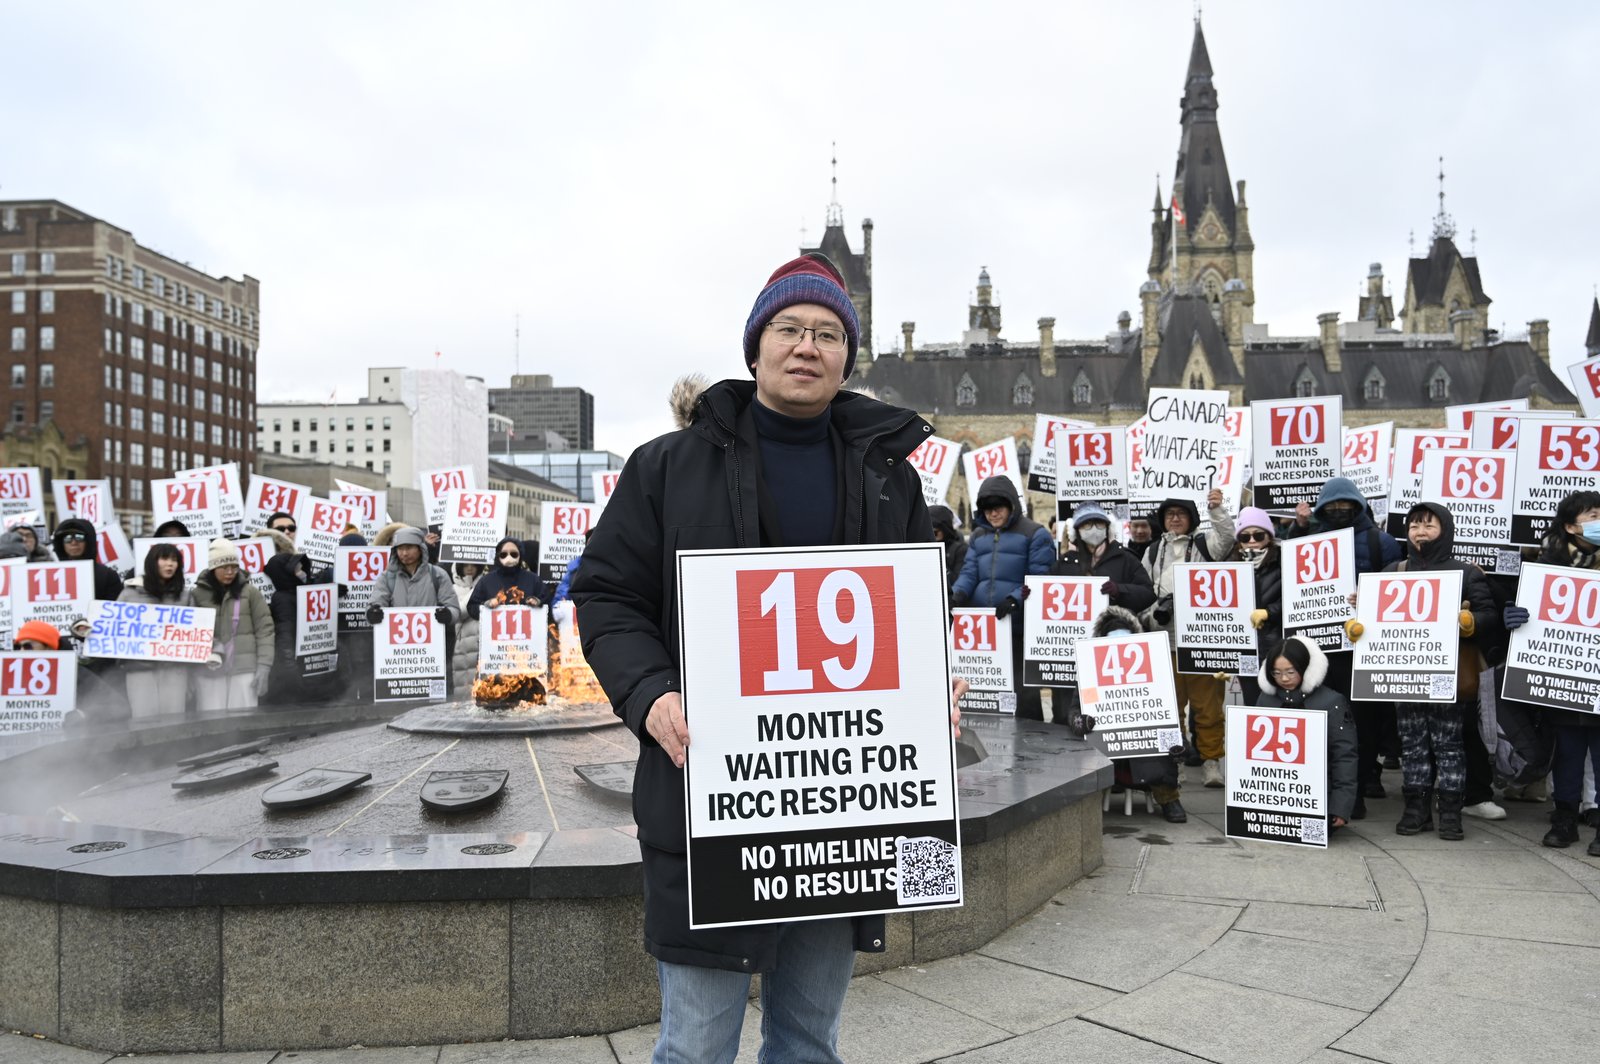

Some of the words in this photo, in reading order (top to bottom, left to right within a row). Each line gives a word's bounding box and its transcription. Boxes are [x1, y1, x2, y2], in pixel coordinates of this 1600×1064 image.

[1149, 396, 1226, 424] CANADA
[1277, 406, 1319, 445] 70
[1074, 434, 1107, 466] 13
[1145, 434, 1188, 460] WHAT
[1186, 439, 1218, 460] ARE
[1276, 448, 1318, 458] MONTHS
[1343, 432, 1374, 466] 23
[1546, 426, 1600, 470] 53
[977, 446, 1005, 479] 32
[1265, 460, 1307, 470] WAITING
[1310, 458, 1330, 467] FOR
[1074, 470, 1108, 478] MONTHS
[1260, 471, 1281, 481] IRCC
[1282, 469, 1335, 479] RESPONSE
[1342, 467, 1372, 477] MONTHS
[1449, 457, 1497, 498] 68
[0, 473, 29, 498] 30
[433, 472, 464, 497] 20
[1066, 479, 1099, 487] WAITING
[1365, 475, 1379, 484] FOR
[1543, 475, 1595, 487] MONTHS
[924, 486, 938, 494] FOR
[1082, 488, 1122, 497] RESPONSE
[1269, 487, 1282, 496] NO
[171, 483, 202, 510] 27
[263, 484, 292, 512] 31
[1273, 496, 1285, 505] NO
[461, 494, 493, 517] 36
[1446, 503, 1495, 513] MONTHS
[1520, 500, 1547, 511] IRCC
[172, 513, 205, 521] MONTHS
[315, 505, 347, 533] 39
[557, 508, 587, 534] 30
[1484, 516, 1507, 526] FOR
[1530, 519, 1543, 529] NO
[304, 539, 334, 551] WAITING
[352, 552, 384, 580] 39
[1300, 540, 1335, 582] 30
[34, 569, 72, 600] 11
[1194, 570, 1234, 608] 30
[1300, 585, 1335, 598] MONTHS
[309, 591, 329, 620] 39
[1047, 584, 1088, 620] 34
[1292, 598, 1326, 611] WAITING
[1329, 595, 1345, 606] FOR
[1382, 580, 1433, 622] 20
[1548, 576, 1600, 627] 90
[33, 604, 73, 614] MONTHS
[101, 602, 148, 621] STOP
[155, 607, 195, 625] THE
[1288, 612, 1306, 623] IRCC
[1307, 606, 1351, 621] RESPONSE
[65, 614, 83, 622] FOR
[1195, 613, 1234, 621] MONTHS
[393, 613, 427, 644] 36
[497, 610, 527, 640] 11
[761, 569, 875, 691] 19
[1046, 626, 1086, 634] MONTHS
[1186, 624, 1224, 633] WAITING
[1226, 625, 1244, 633] FOR
[1306, 625, 1342, 637] TIMELINES
[958, 615, 992, 650] 31
[1381, 629, 1430, 639] MONTHS
[1543, 628, 1600, 646] MONTHS
[1036, 637, 1074, 646] WAITING
[1181, 634, 1201, 643] IRCC
[1203, 635, 1251, 645] RESPONSE
[393, 648, 427, 656] MONTHS
[1369, 641, 1416, 652] WAITING
[1419, 641, 1442, 651] FOR
[1527, 639, 1583, 657] WAITING
[958, 656, 993, 664] MONTHS
[1191, 651, 1201, 659] NO
[1361, 655, 1386, 665] IRCC
[1388, 655, 1449, 665] RESPONSE
[1516, 652, 1546, 667] IRCC
[385, 657, 418, 666] WAITING
[1102, 644, 1148, 685] 42
[1194, 660, 1205, 668] NO
[1207, 661, 1239, 669] RESULTS
[380, 667, 398, 675] IRCC
[399, 666, 441, 674] RESPONSE
[952, 667, 984, 675] WAITING
[986, 667, 1002, 675] FOR
[1042, 672, 1053, 680] NO
[8, 659, 51, 695] 18
[1371, 674, 1384, 683] NO
[1527, 674, 1542, 685] NO
[1105, 687, 1150, 700] MONTHS
[1374, 684, 1387, 693] NO
[1530, 685, 1546, 697] NO
[6, 700, 51, 709] MONTHS
[968, 701, 997, 710] RESULTS
[1095, 700, 1139, 713] WAITING
[1142, 698, 1163, 710] FOR
[41, 711, 62, 719] FOR
[1115, 710, 1171, 723] RESPONSE
[758, 708, 884, 742] MONTHS
[1102, 732, 1115, 742] NO
[1251, 716, 1300, 763] 25
[1107, 742, 1121, 751] NO
[725, 747, 852, 783] WAITING
[862, 744, 918, 777] FOR
[1251, 766, 1298, 780] MONTHS
[1240, 779, 1285, 793] WAITING
[1289, 783, 1311, 795] FOR
[709, 790, 775, 821] IRCC
[780, 780, 937, 816] RESPONSE
[1233, 791, 1256, 803] IRCC
[1258, 795, 1318, 809] RESPONSE
[1243, 811, 1256, 821] NO
[1247, 823, 1260, 833] NO
[741, 843, 776, 870] NO
[754, 876, 788, 901] NO
[795, 867, 897, 896] RESULTS
